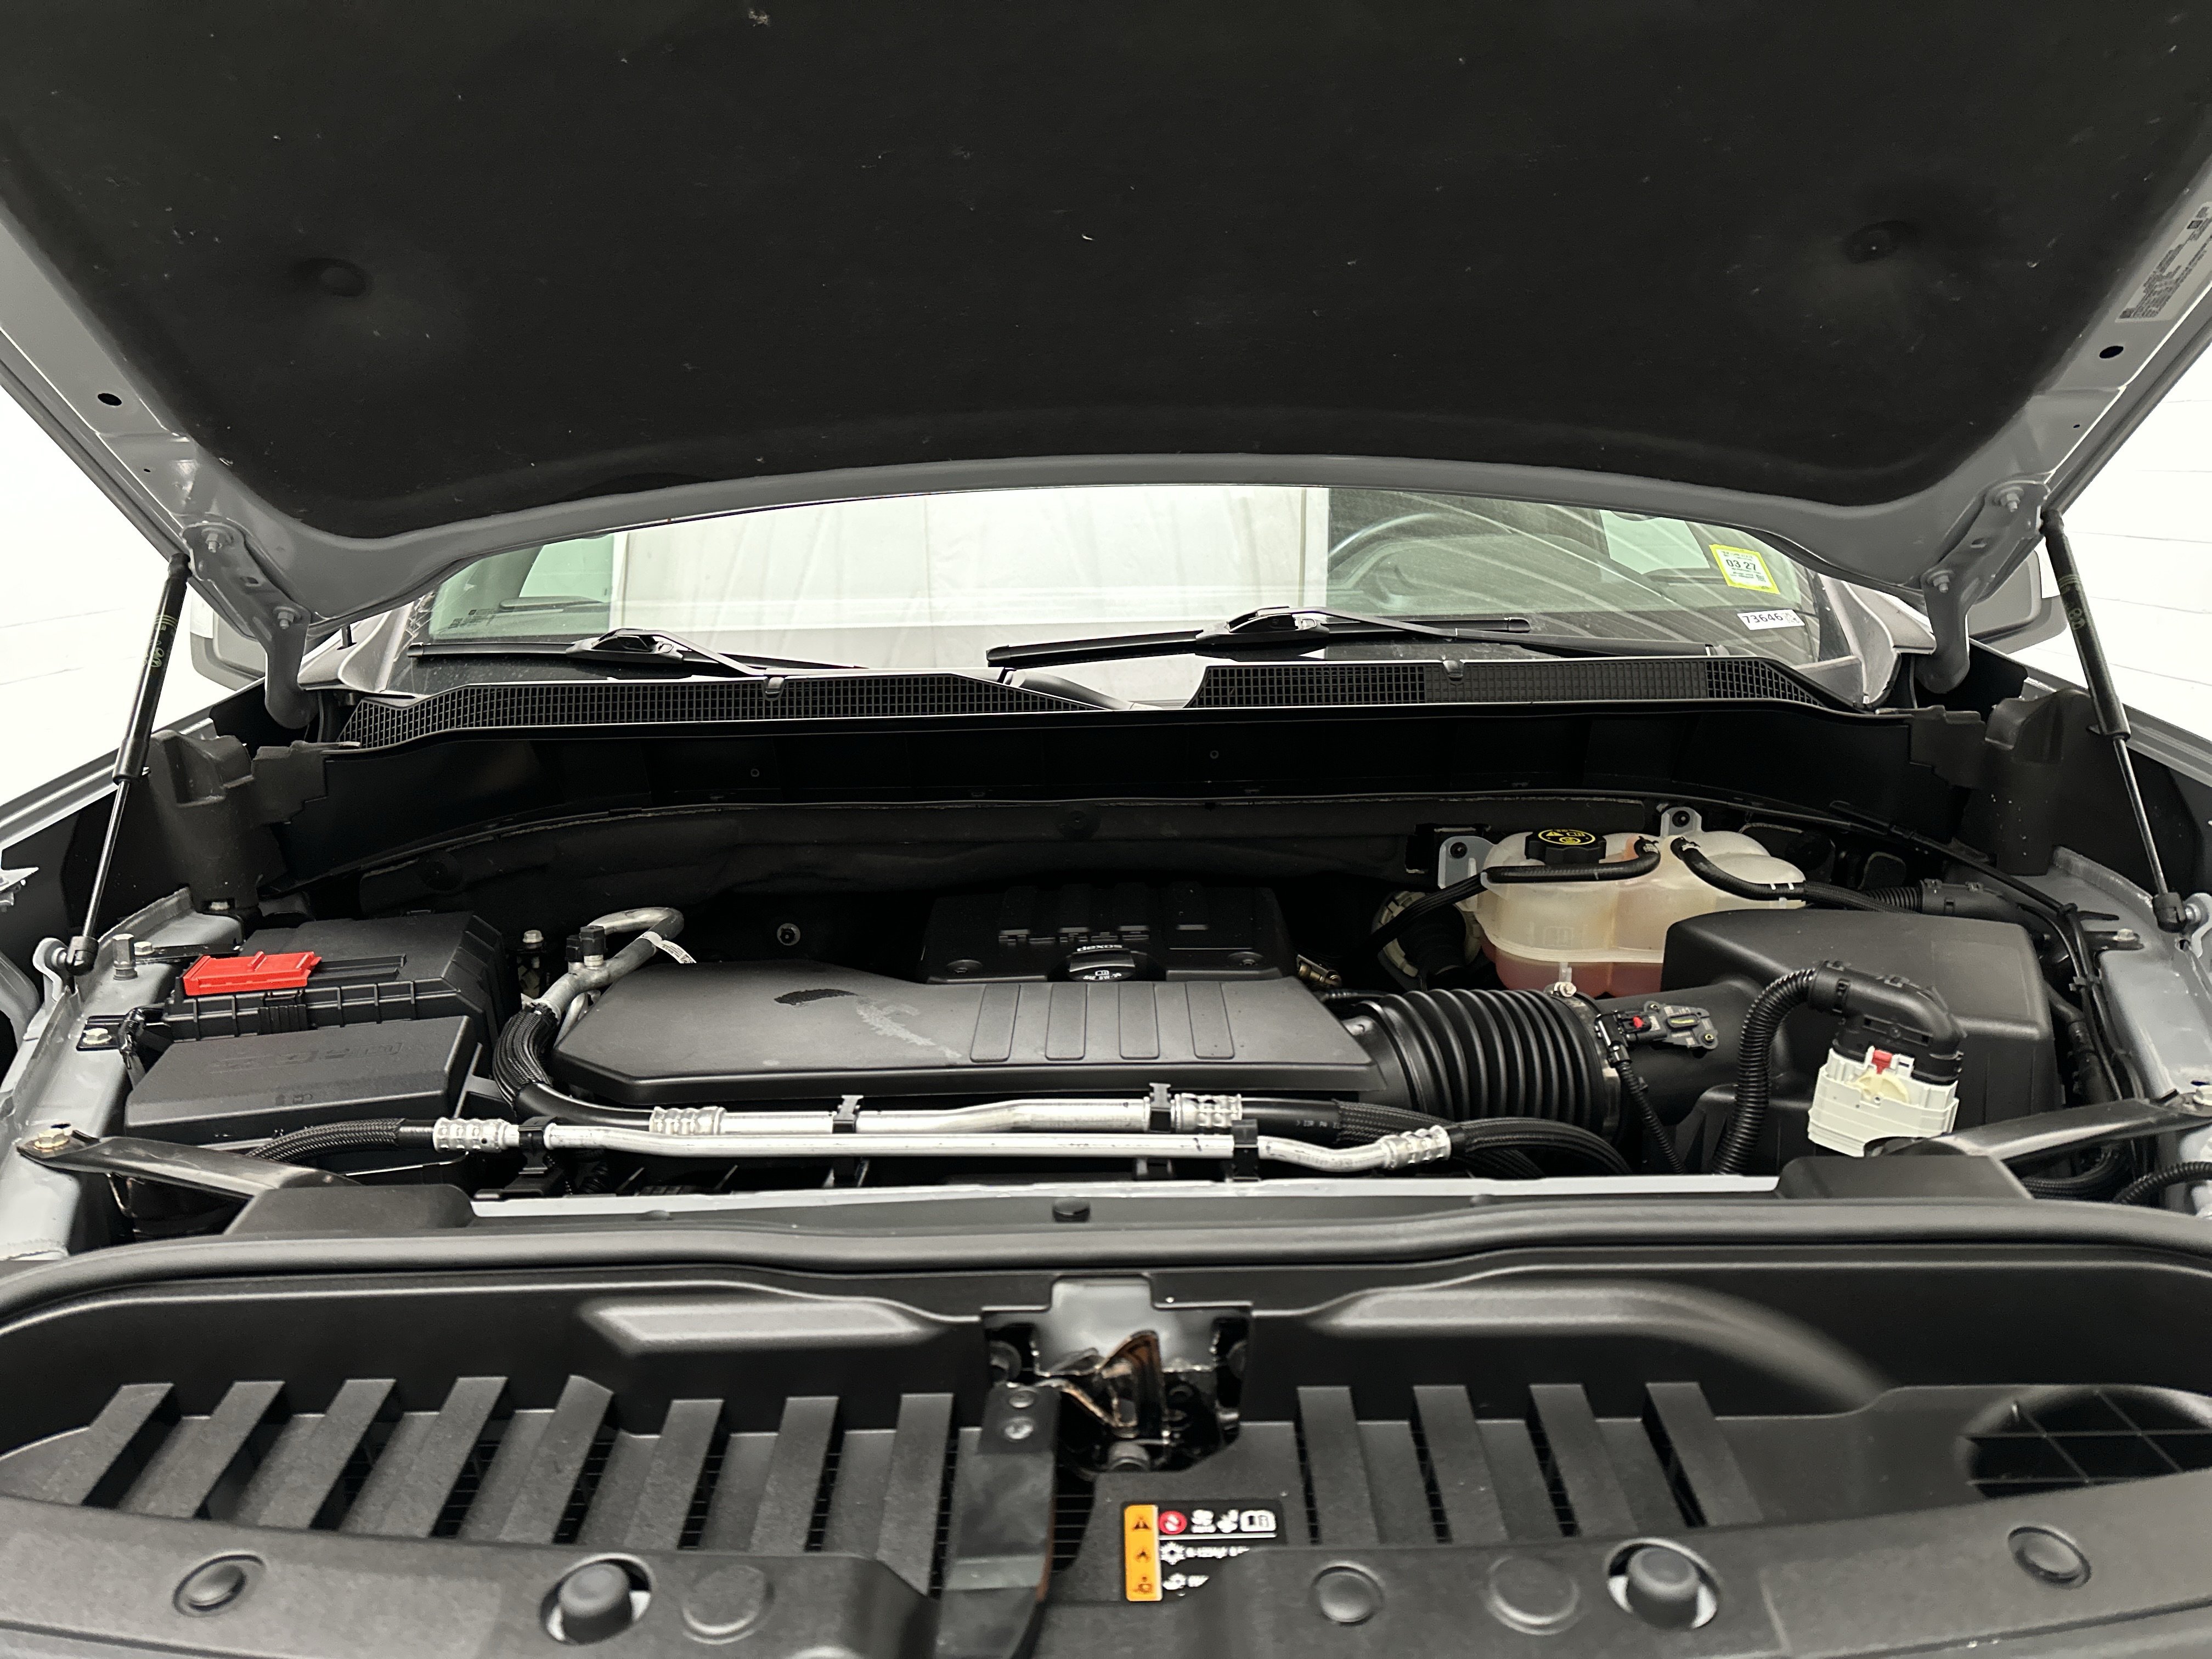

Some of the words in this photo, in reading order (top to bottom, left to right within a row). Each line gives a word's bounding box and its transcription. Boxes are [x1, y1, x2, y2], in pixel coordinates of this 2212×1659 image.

[1726, 559, 1741, 568] 03
[1743, 561, 1757, 571] 27
[1742, 613, 1784, 624] 73646
